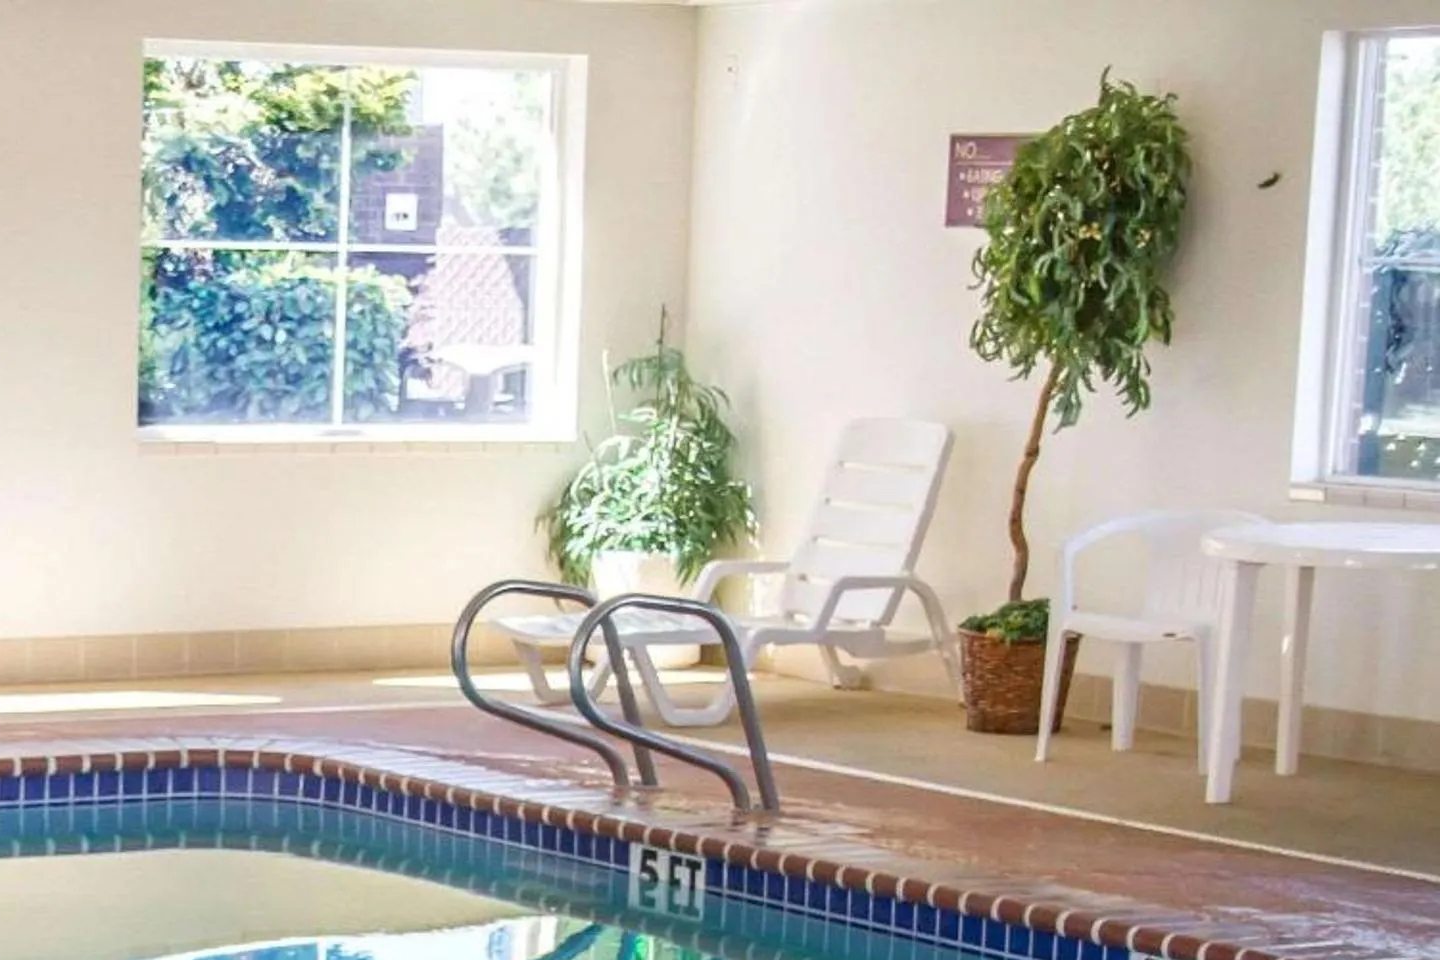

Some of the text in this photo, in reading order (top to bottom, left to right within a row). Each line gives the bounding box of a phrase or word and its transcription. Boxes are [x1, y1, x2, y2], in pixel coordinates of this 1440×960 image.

[956, 142, 977, 159] NO
[640, 849, 701, 892] 5 FT
